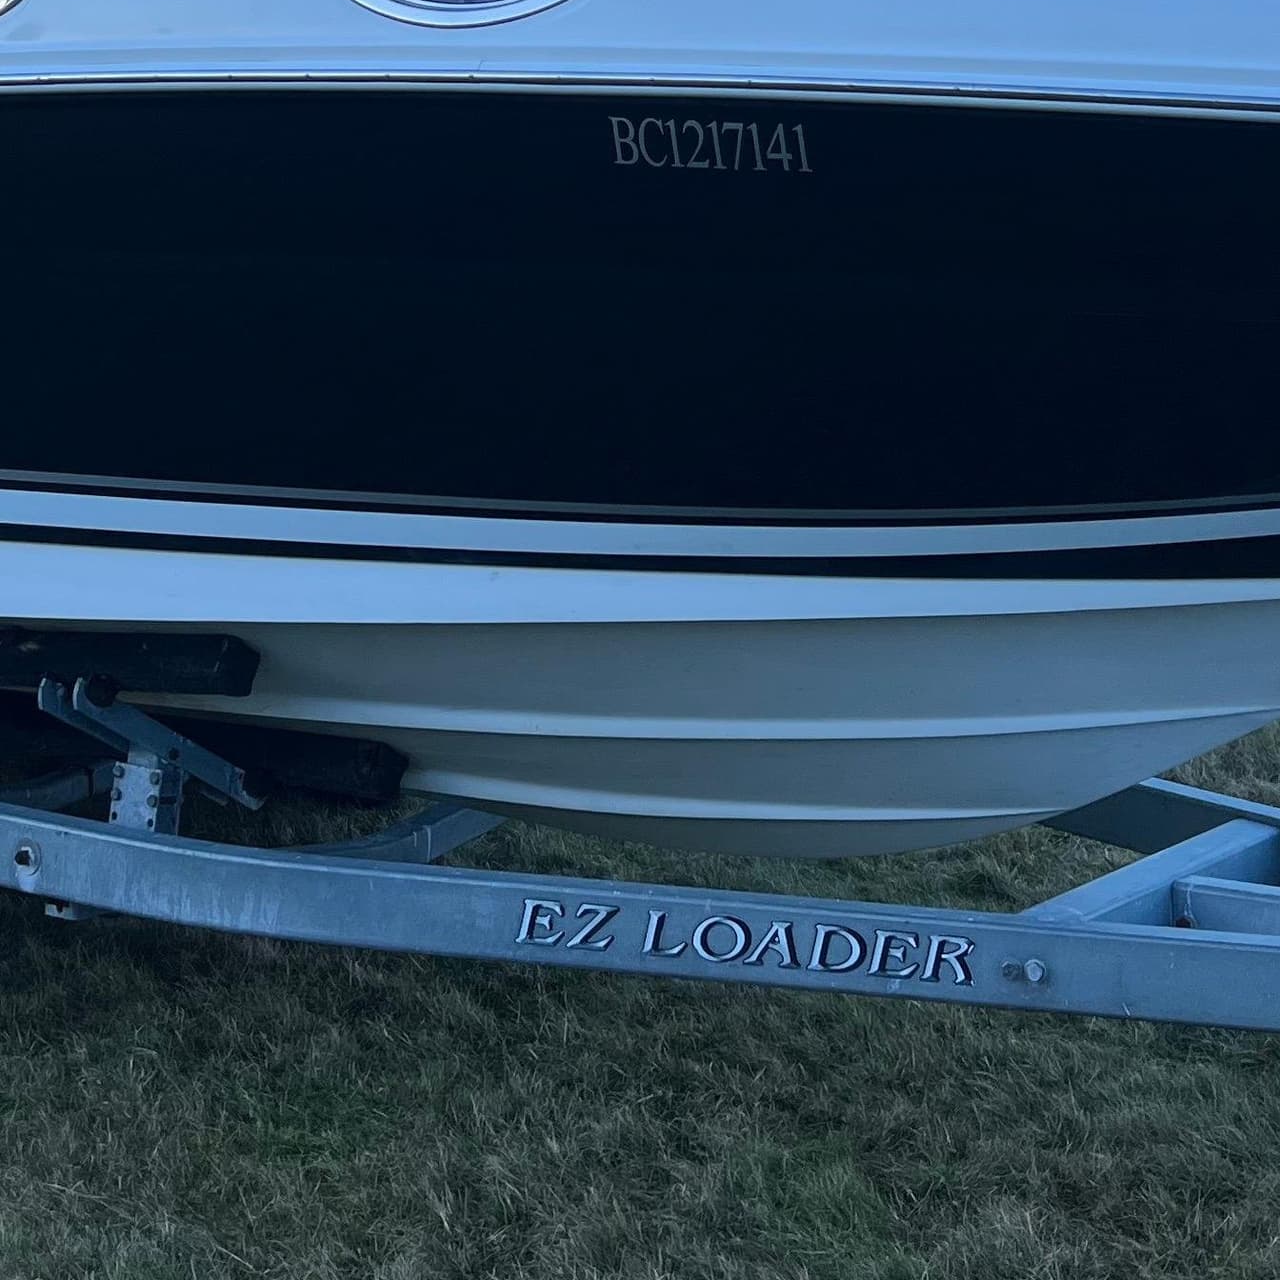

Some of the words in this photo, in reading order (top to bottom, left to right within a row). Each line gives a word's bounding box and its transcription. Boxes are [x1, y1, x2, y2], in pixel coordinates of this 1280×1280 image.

[608, 115, 814, 173] BC1217141
[515, 898, 620, 952] EZ
[641, 909, 976, 987] LOADER
